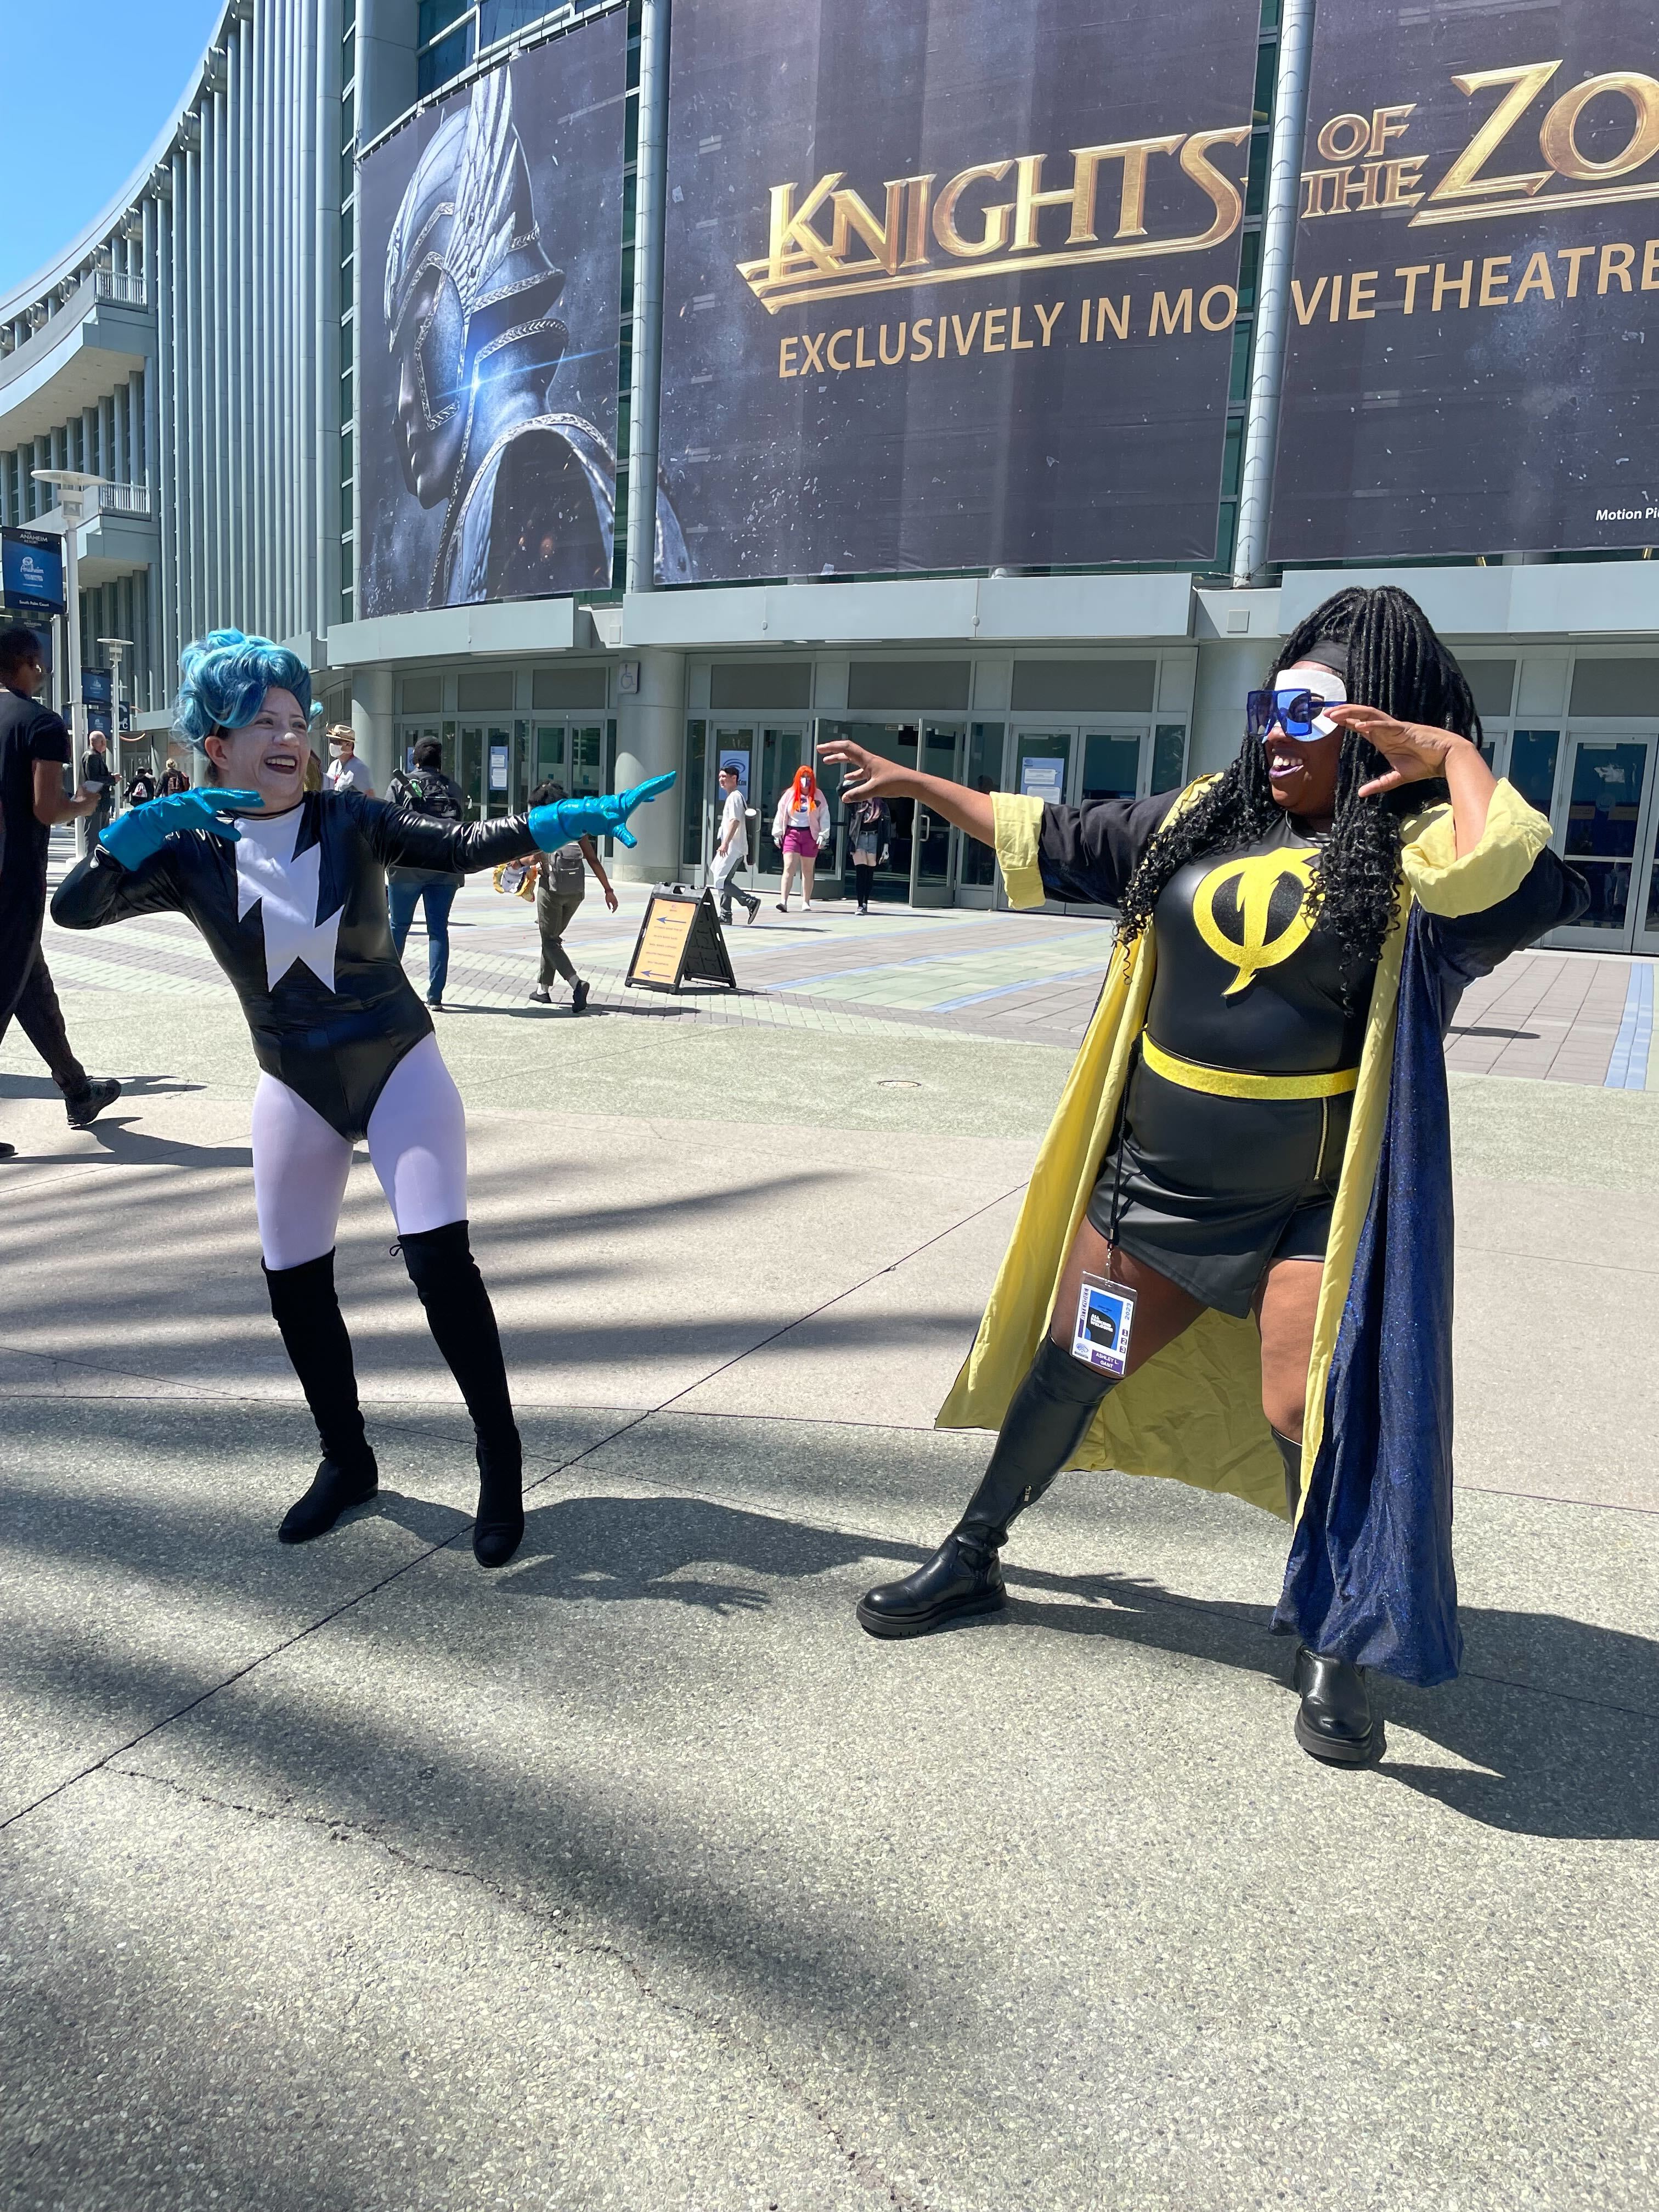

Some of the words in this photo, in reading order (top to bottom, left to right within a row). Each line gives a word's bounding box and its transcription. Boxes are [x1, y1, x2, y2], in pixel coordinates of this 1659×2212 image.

[1317, 103, 1417, 161] OF
[737, 125, 1252, 307] KNIGHTS
[1299, 154, 1430, 220] THE
[1395, 238, 1659, 315] THEATRE
[778, 302, 1065, 379] EXCLUSIVELY
[1080, 295, 1131, 343] IN
[20, 534, 48, 542] ANAHEIM
[1595, 508, 1642, 521] Motion
[1096, 1352, 1114, 1362] ASHLEY
[1100, 1360, 1114, 1368] GANT
